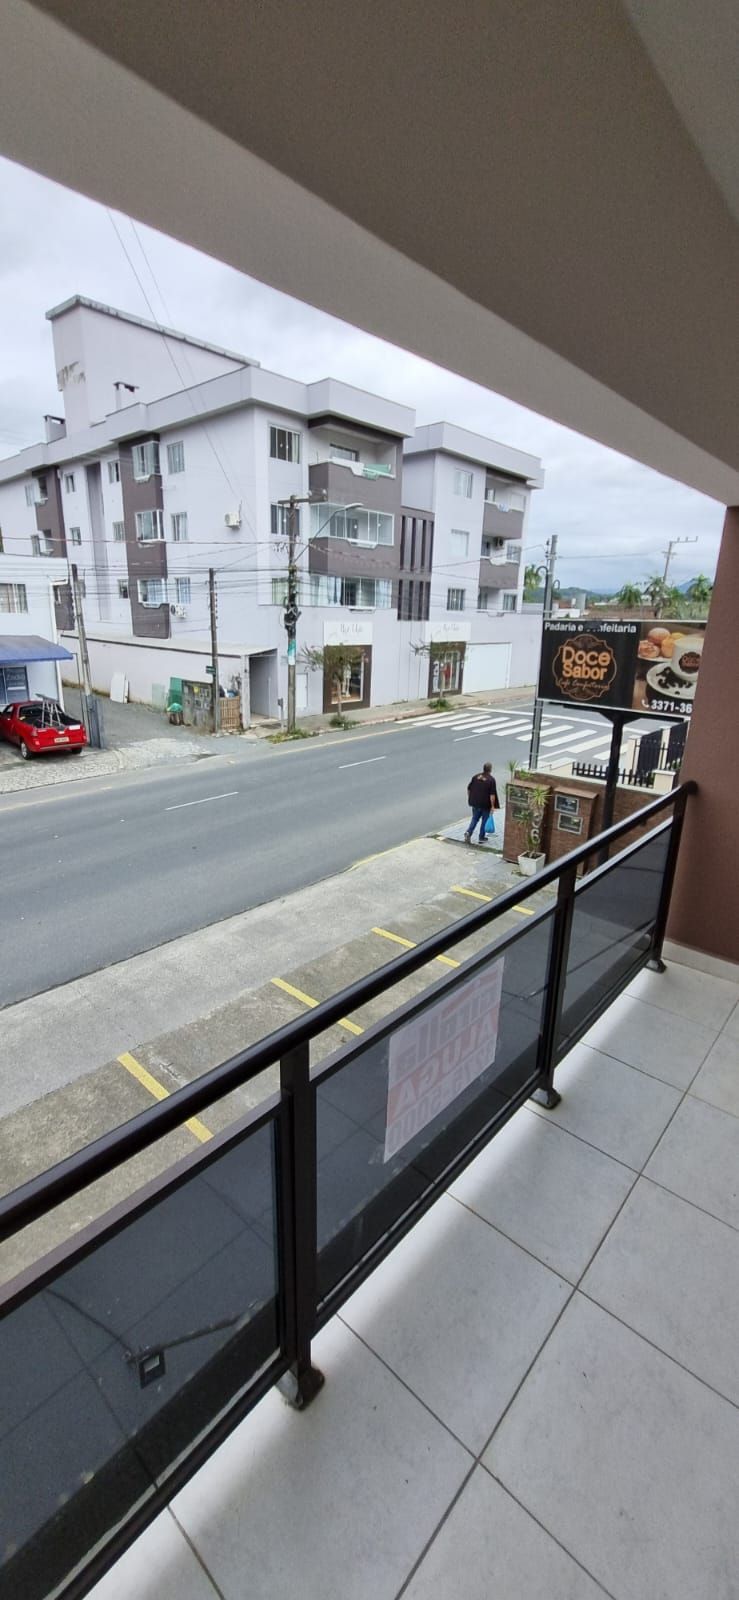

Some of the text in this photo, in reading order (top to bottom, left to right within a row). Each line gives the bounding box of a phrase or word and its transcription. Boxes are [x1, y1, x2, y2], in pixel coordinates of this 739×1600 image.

[544, 622, 576, 632] Padaria
[578, 624, 584, 632] e
[562, 646, 611, 666] Doce
[562, 660, 608, 680] Sabor
